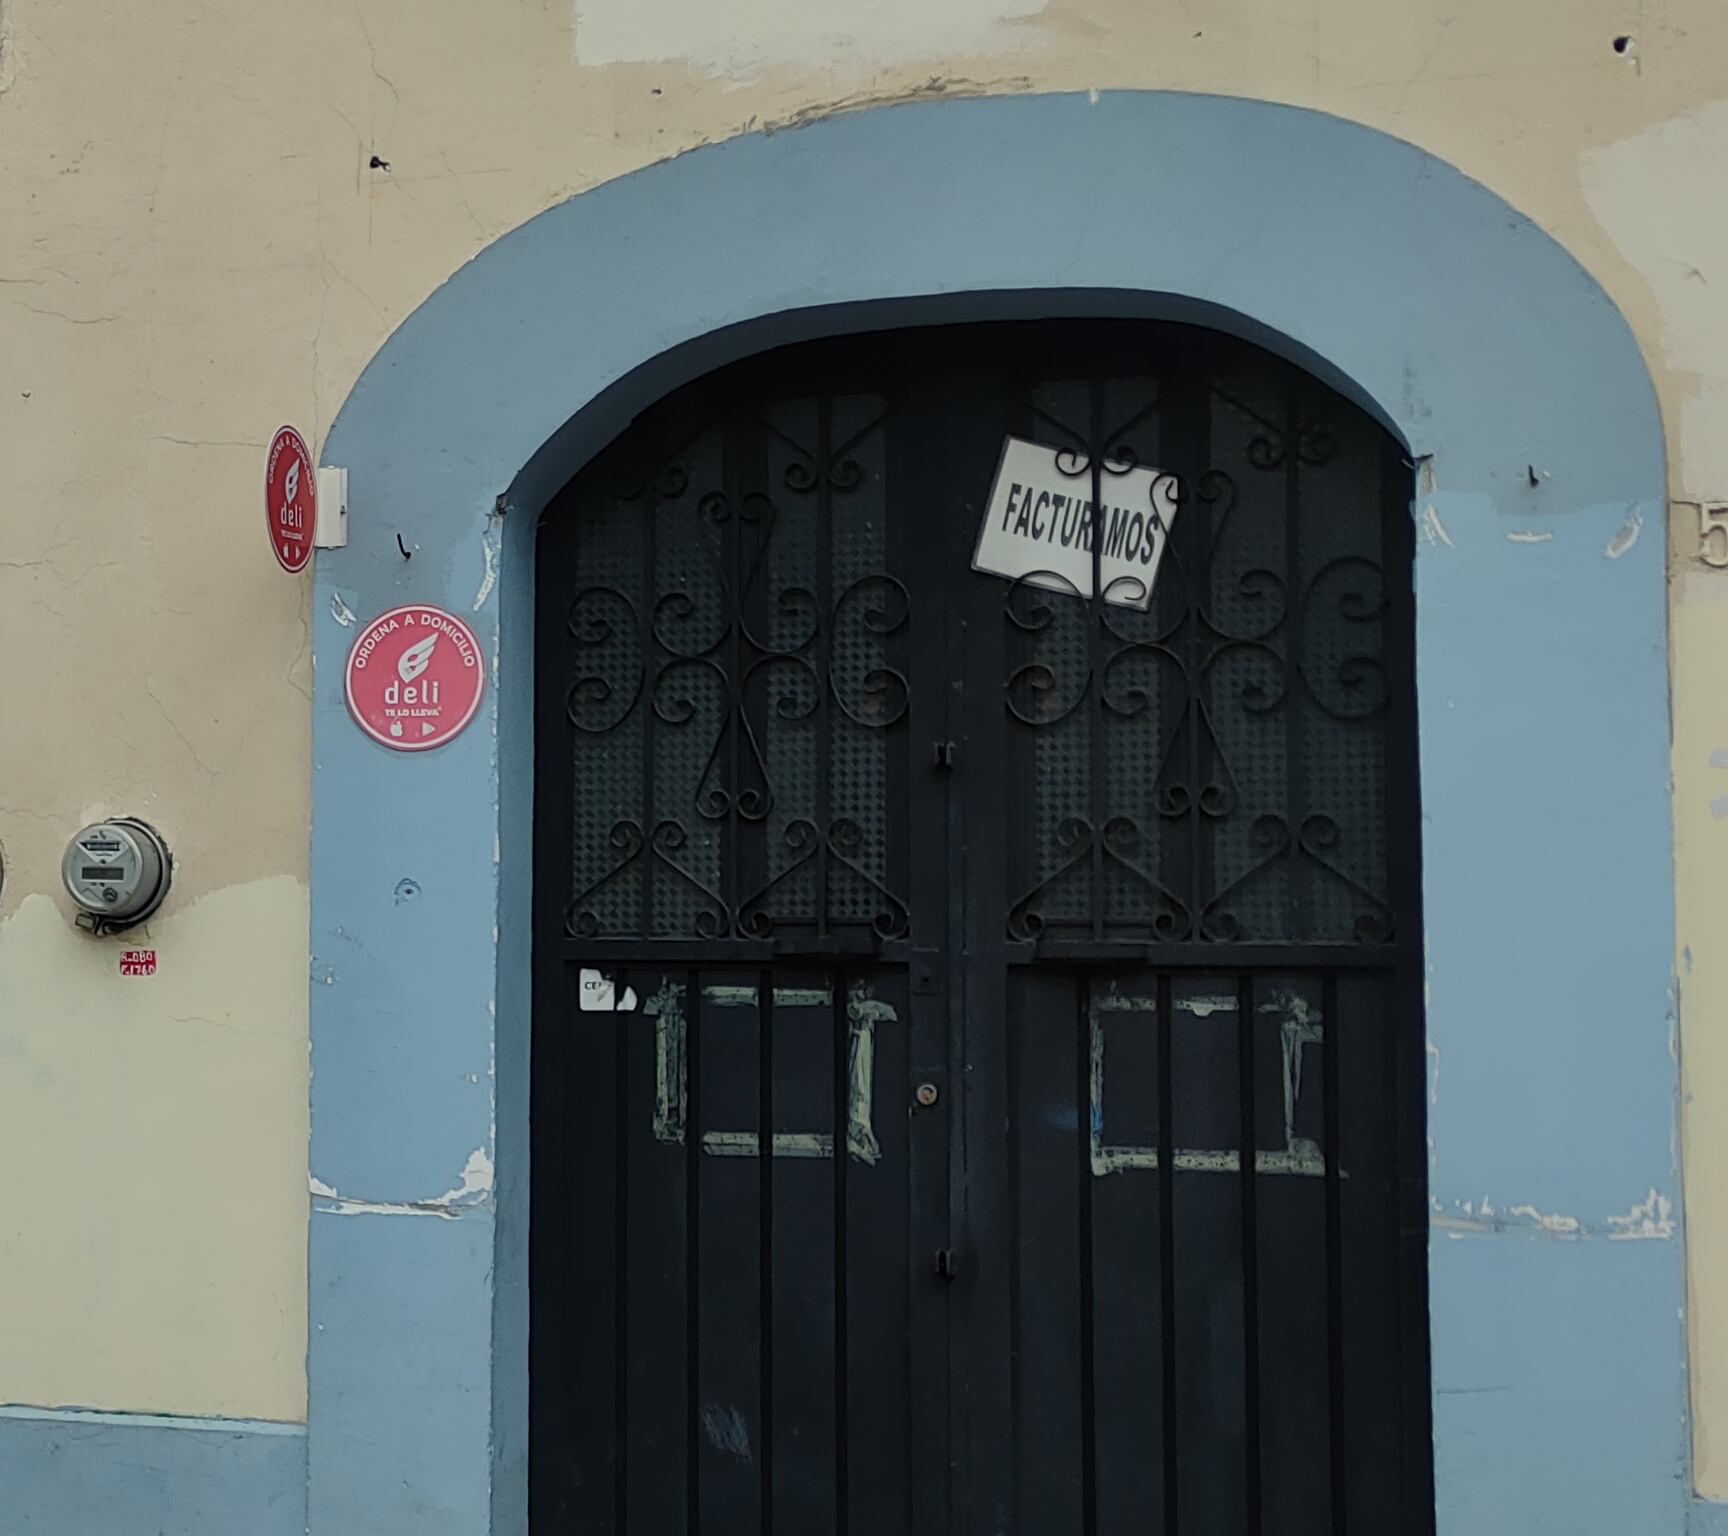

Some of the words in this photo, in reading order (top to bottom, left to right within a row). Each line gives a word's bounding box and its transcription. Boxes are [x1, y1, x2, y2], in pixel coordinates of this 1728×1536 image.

[280, 501, 302, 529] deli
[1001, 482, 1161, 566] FACTURAMOS
[355, 619, 400, 669] ORDENA
[404, 614, 415, 626] A
[420, 614, 475, 667] DOMICILIO
[384, 679, 439, 704] deli
[384, 709, 395, 717] TE
[397, 709, 410, 717] LO
